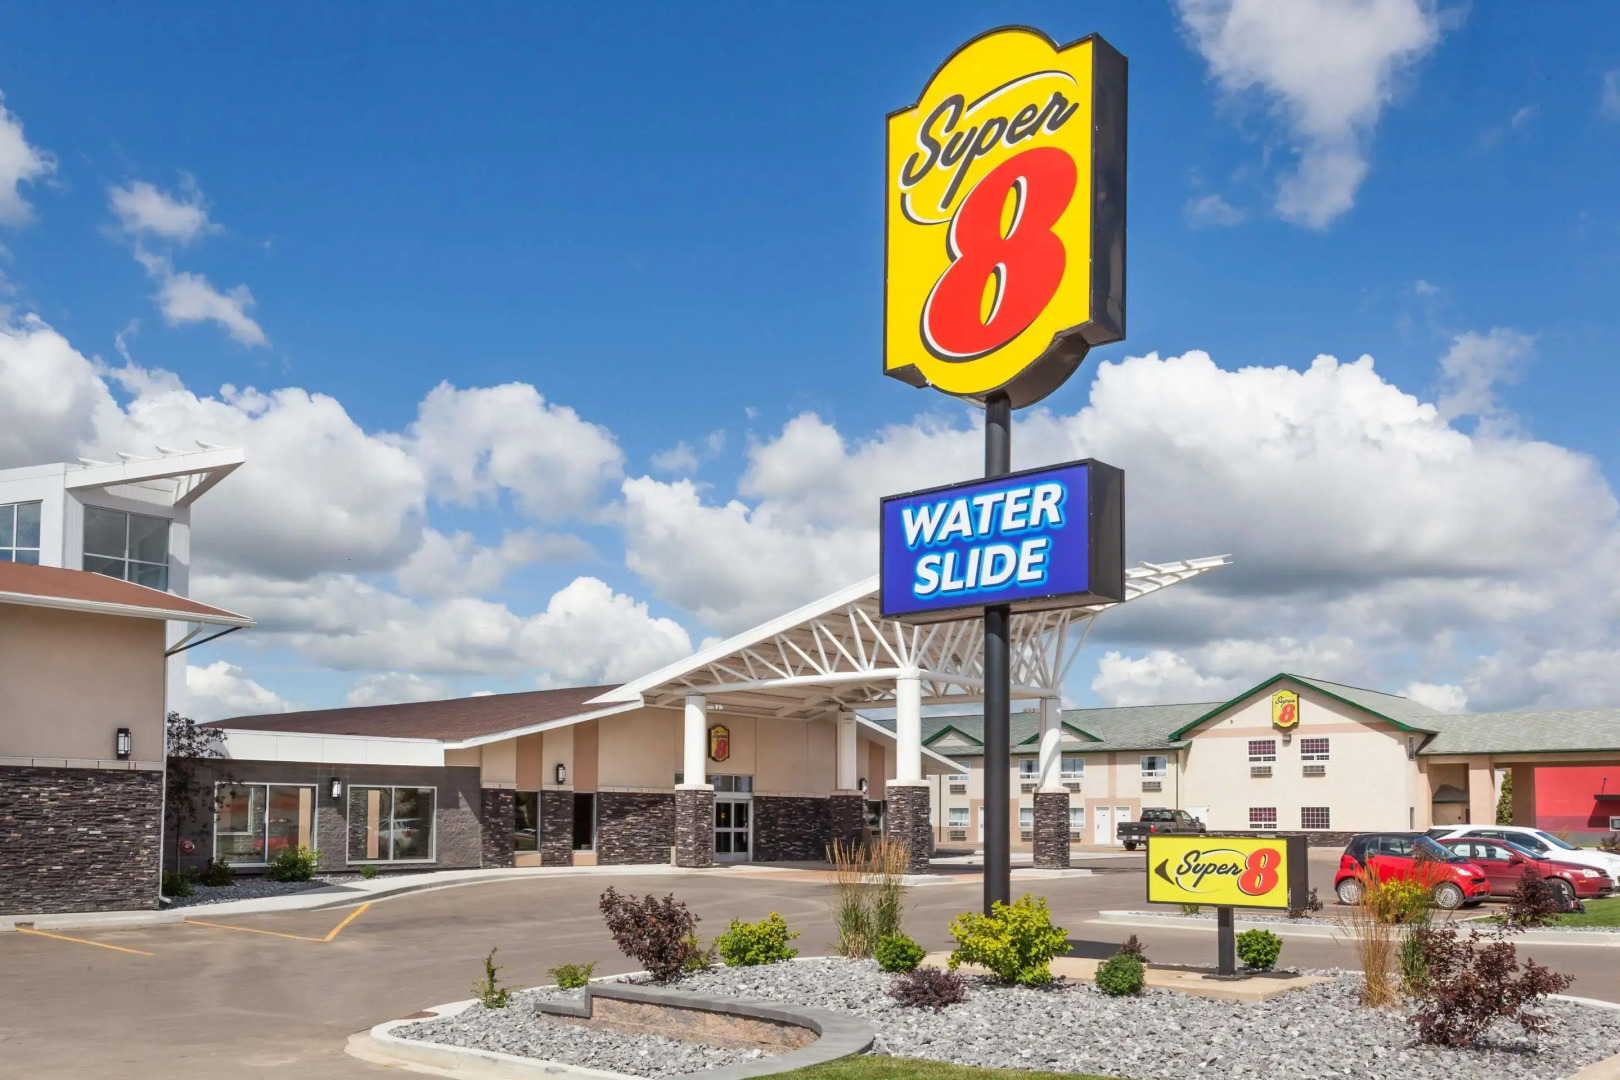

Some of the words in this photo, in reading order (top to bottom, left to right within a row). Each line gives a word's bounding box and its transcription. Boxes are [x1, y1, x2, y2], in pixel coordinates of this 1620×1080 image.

[899, 93, 1080, 212] Super
[919, 146, 1078, 364] 8
[902, 482, 1065, 548] WATER
[914, 537, 1050, 597] SLIDE
[1279, 704, 1295, 723] 8
[714, 739, 727, 759] 8
[1175, 849, 1243, 888] Super
[1237, 848, 1281, 896] 8
